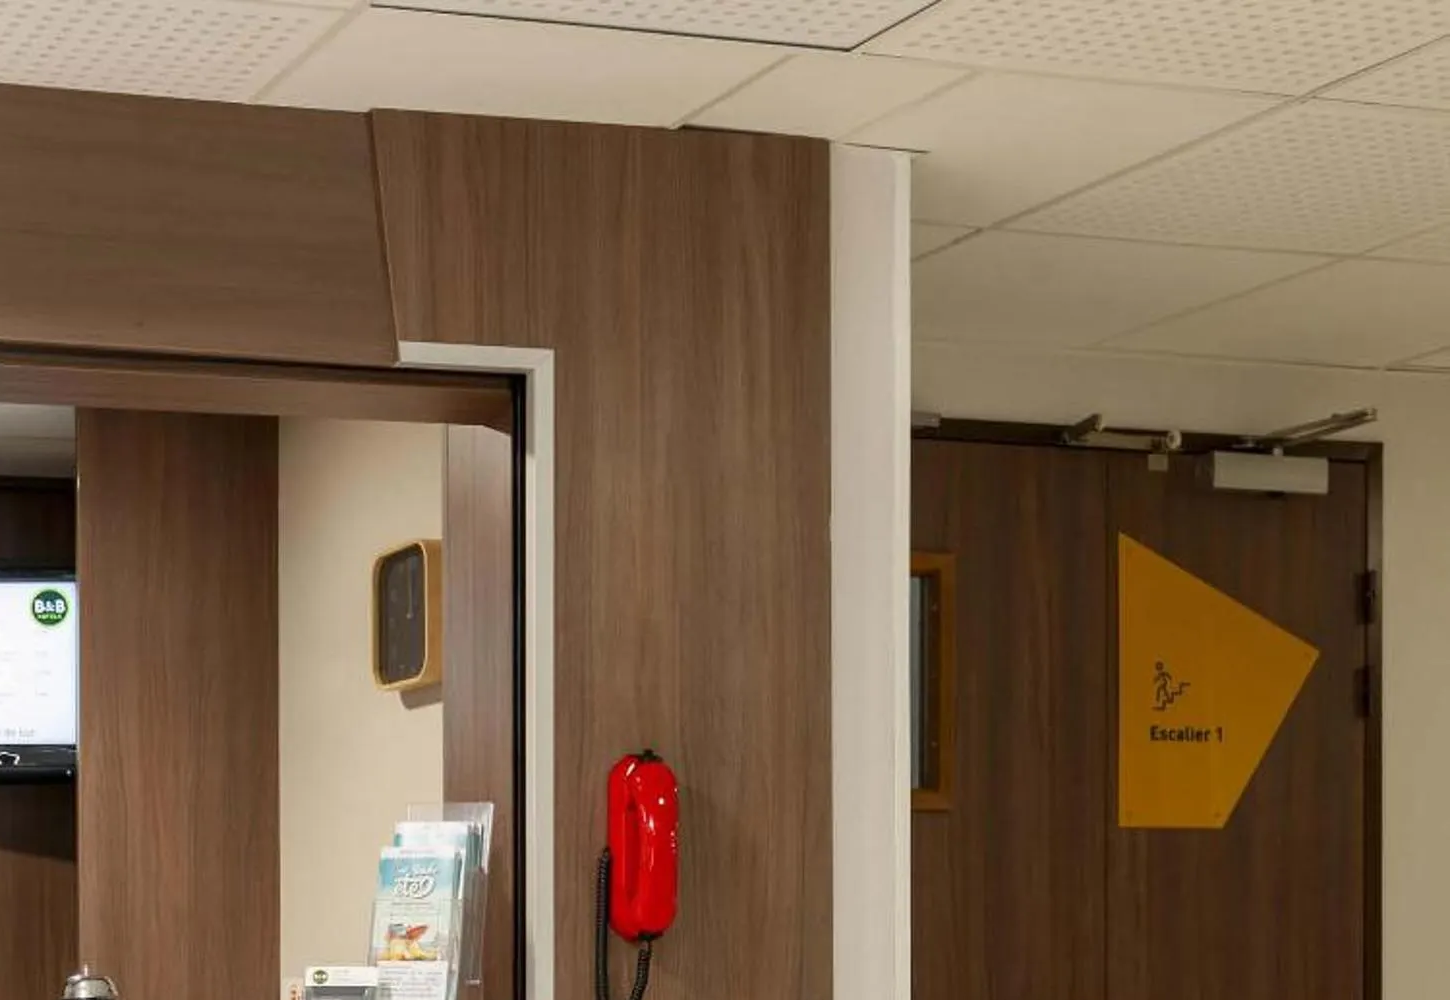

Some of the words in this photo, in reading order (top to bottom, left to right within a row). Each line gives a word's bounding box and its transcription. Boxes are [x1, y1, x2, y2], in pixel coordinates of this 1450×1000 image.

[34, 598, 66, 614] B&B
[1150, 725, 1211, 742] Escalier
[1215, 726, 1224, 743] 1
